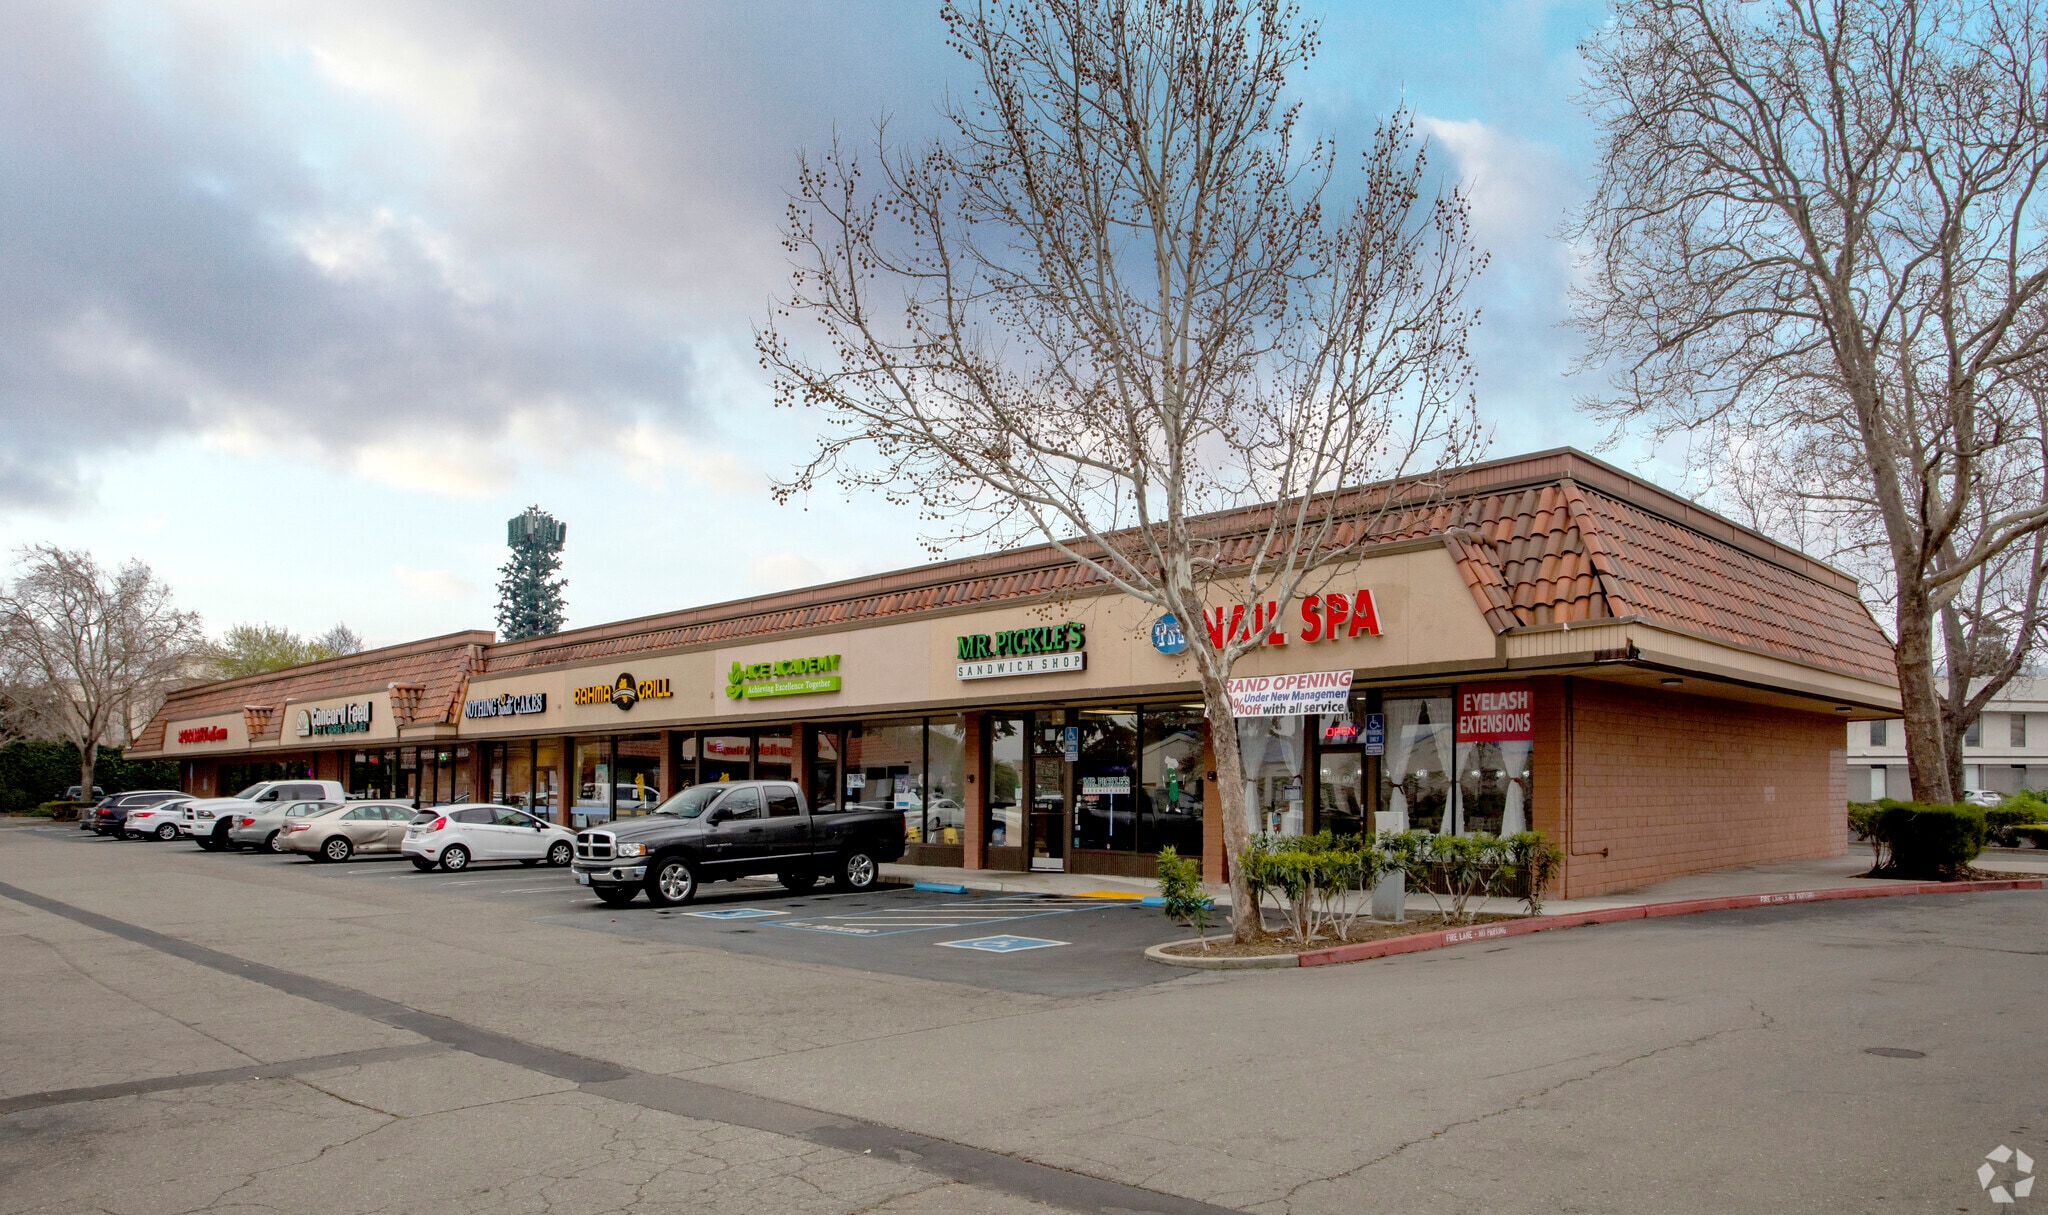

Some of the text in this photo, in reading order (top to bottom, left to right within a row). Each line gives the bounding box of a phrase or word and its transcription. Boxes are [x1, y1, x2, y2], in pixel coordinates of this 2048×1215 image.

[1203, 589, 1384, 650] NAIL SPA
[957, 621, 1085, 659] MR. PICKLE'S
[745, 654, 841, 679] ACE ACADEMY
[958, 656, 1081, 677] SANDWICH SHOP
[573, 685, 612, 705] RAHMA
[637, 678, 671, 699] GRILL
[747, 679, 831, 694] Achieving Excellence Together
[1226, 671, 1352, 694] RAND OPENING
[464, 698, 497, 718] NOTHING
[513, 693, 543, 714] CAKES
[1243, 689, 1348, 703] Under New Managemen
[1463, 690, 1528, 712] EYELASH
[311, 701, 370, 726] Concord Feed
[1262, 703, 1287, 715] with
[1288, 702, 1303, 714] all
[1304, 700, 1344, 713] service
[1325, 726, 1356, 737] OPEN
[1460, 712, 1531, 734] EXTENSIONS
[1446, 933, 1458, 942] FIRE
[1459, 930, 1473, 941] LANE
[1478, 929, 1486, 937] NO
[1487, 927, 1507, 936] PARKING
